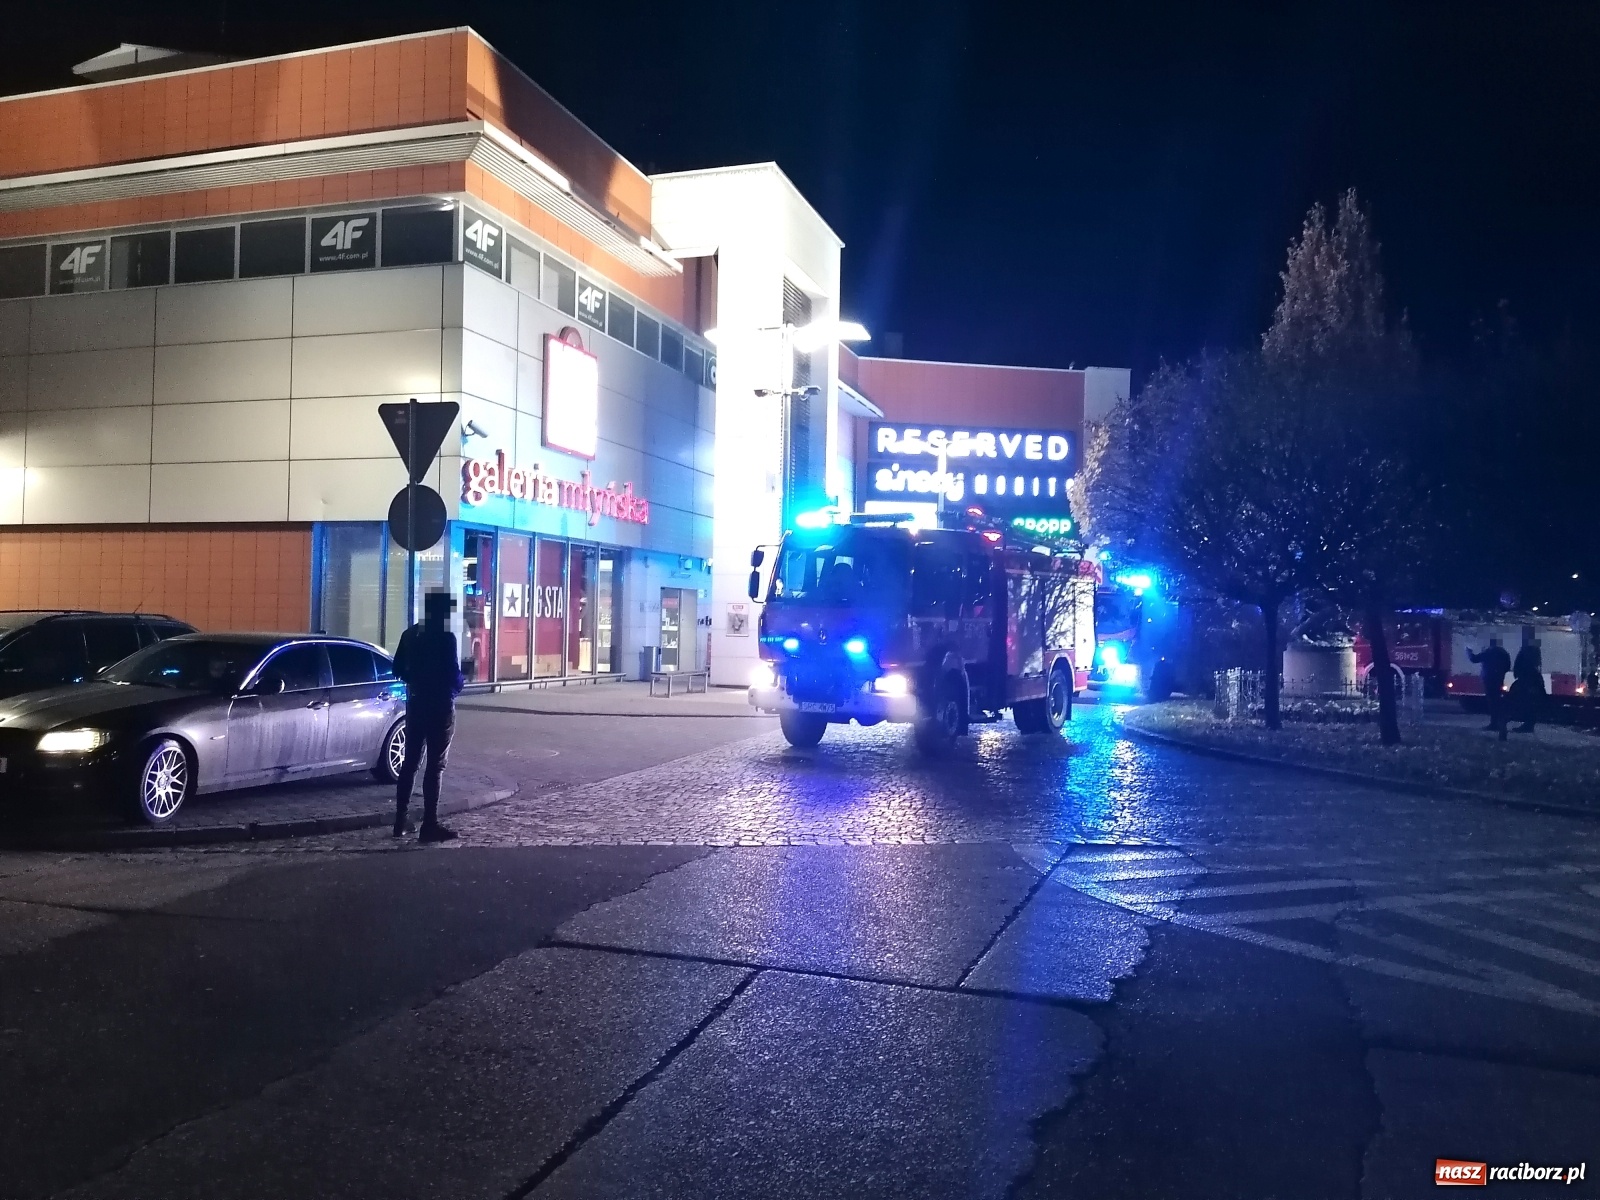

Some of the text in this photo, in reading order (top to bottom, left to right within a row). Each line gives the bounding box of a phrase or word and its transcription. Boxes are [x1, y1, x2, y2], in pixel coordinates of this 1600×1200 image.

[320, 218, 370, 250] 4F
[465, 219, 499, 252] 4F
[60, 245, 102, 274] 4F
[579, 286, 604, 314] 4F
[877, 427, 1069, 460] RESERVED
[545, 586, 563, 618] STA
